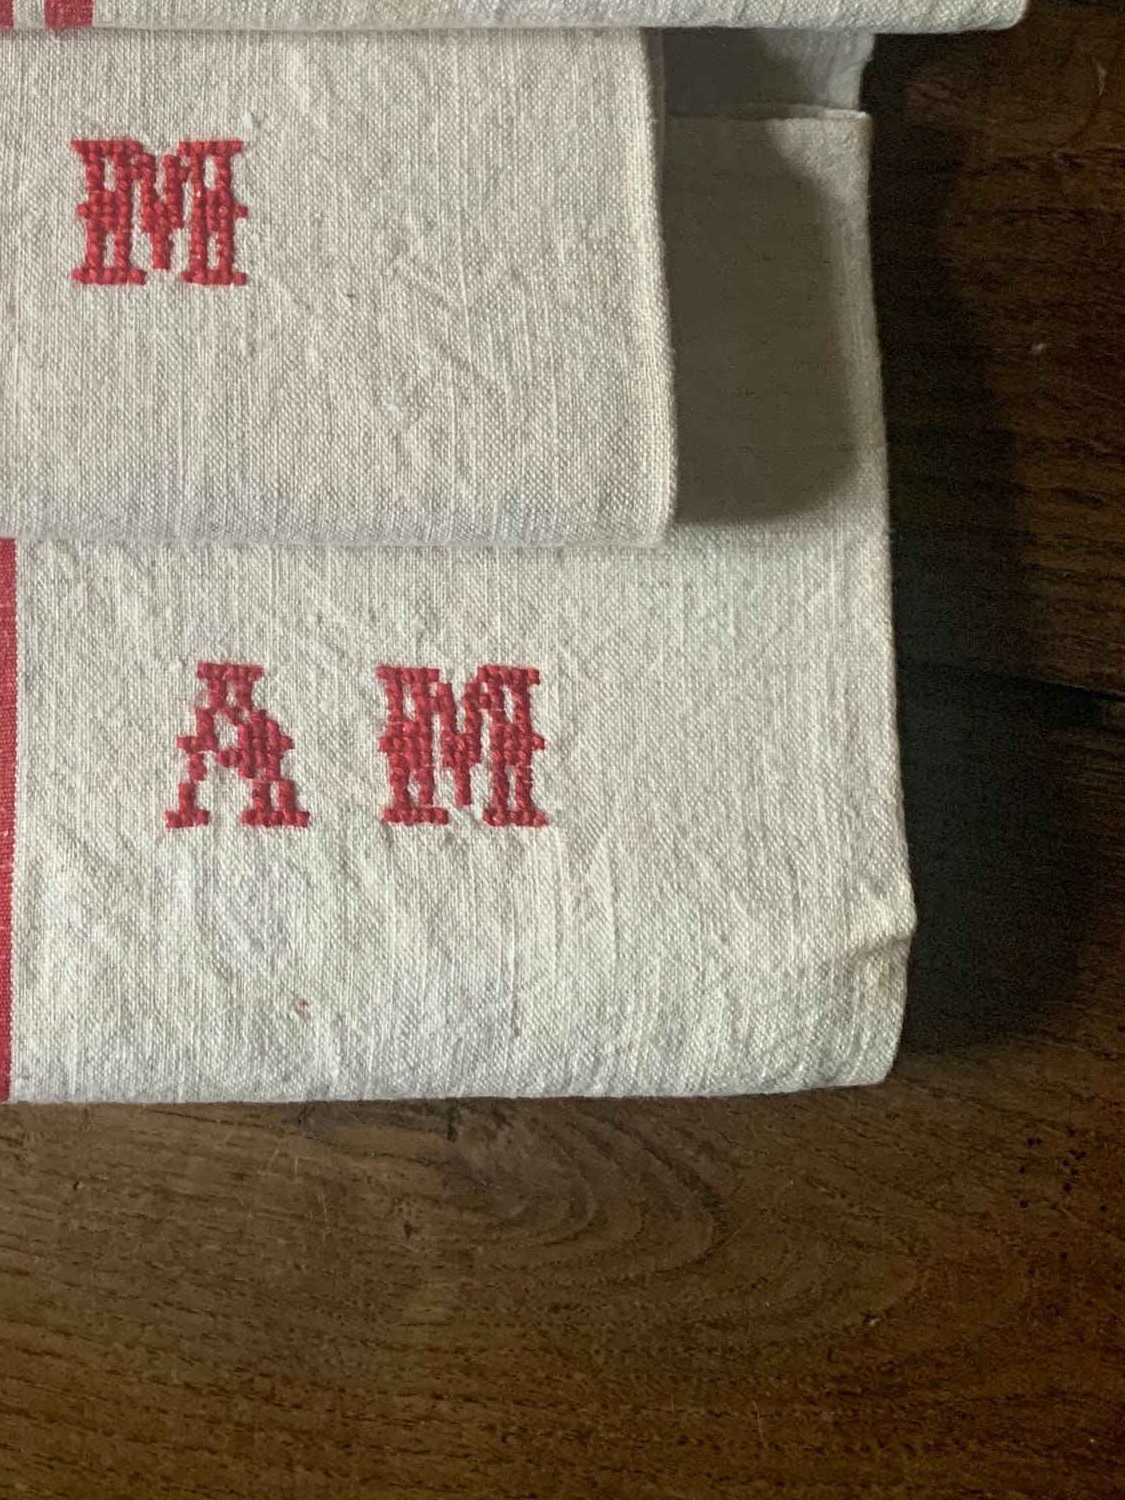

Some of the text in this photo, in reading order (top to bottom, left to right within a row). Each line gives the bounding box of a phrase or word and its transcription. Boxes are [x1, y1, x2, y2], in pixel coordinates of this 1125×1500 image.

[71, 138, 248, 286] M
[165, 662, 548, 828] A M
